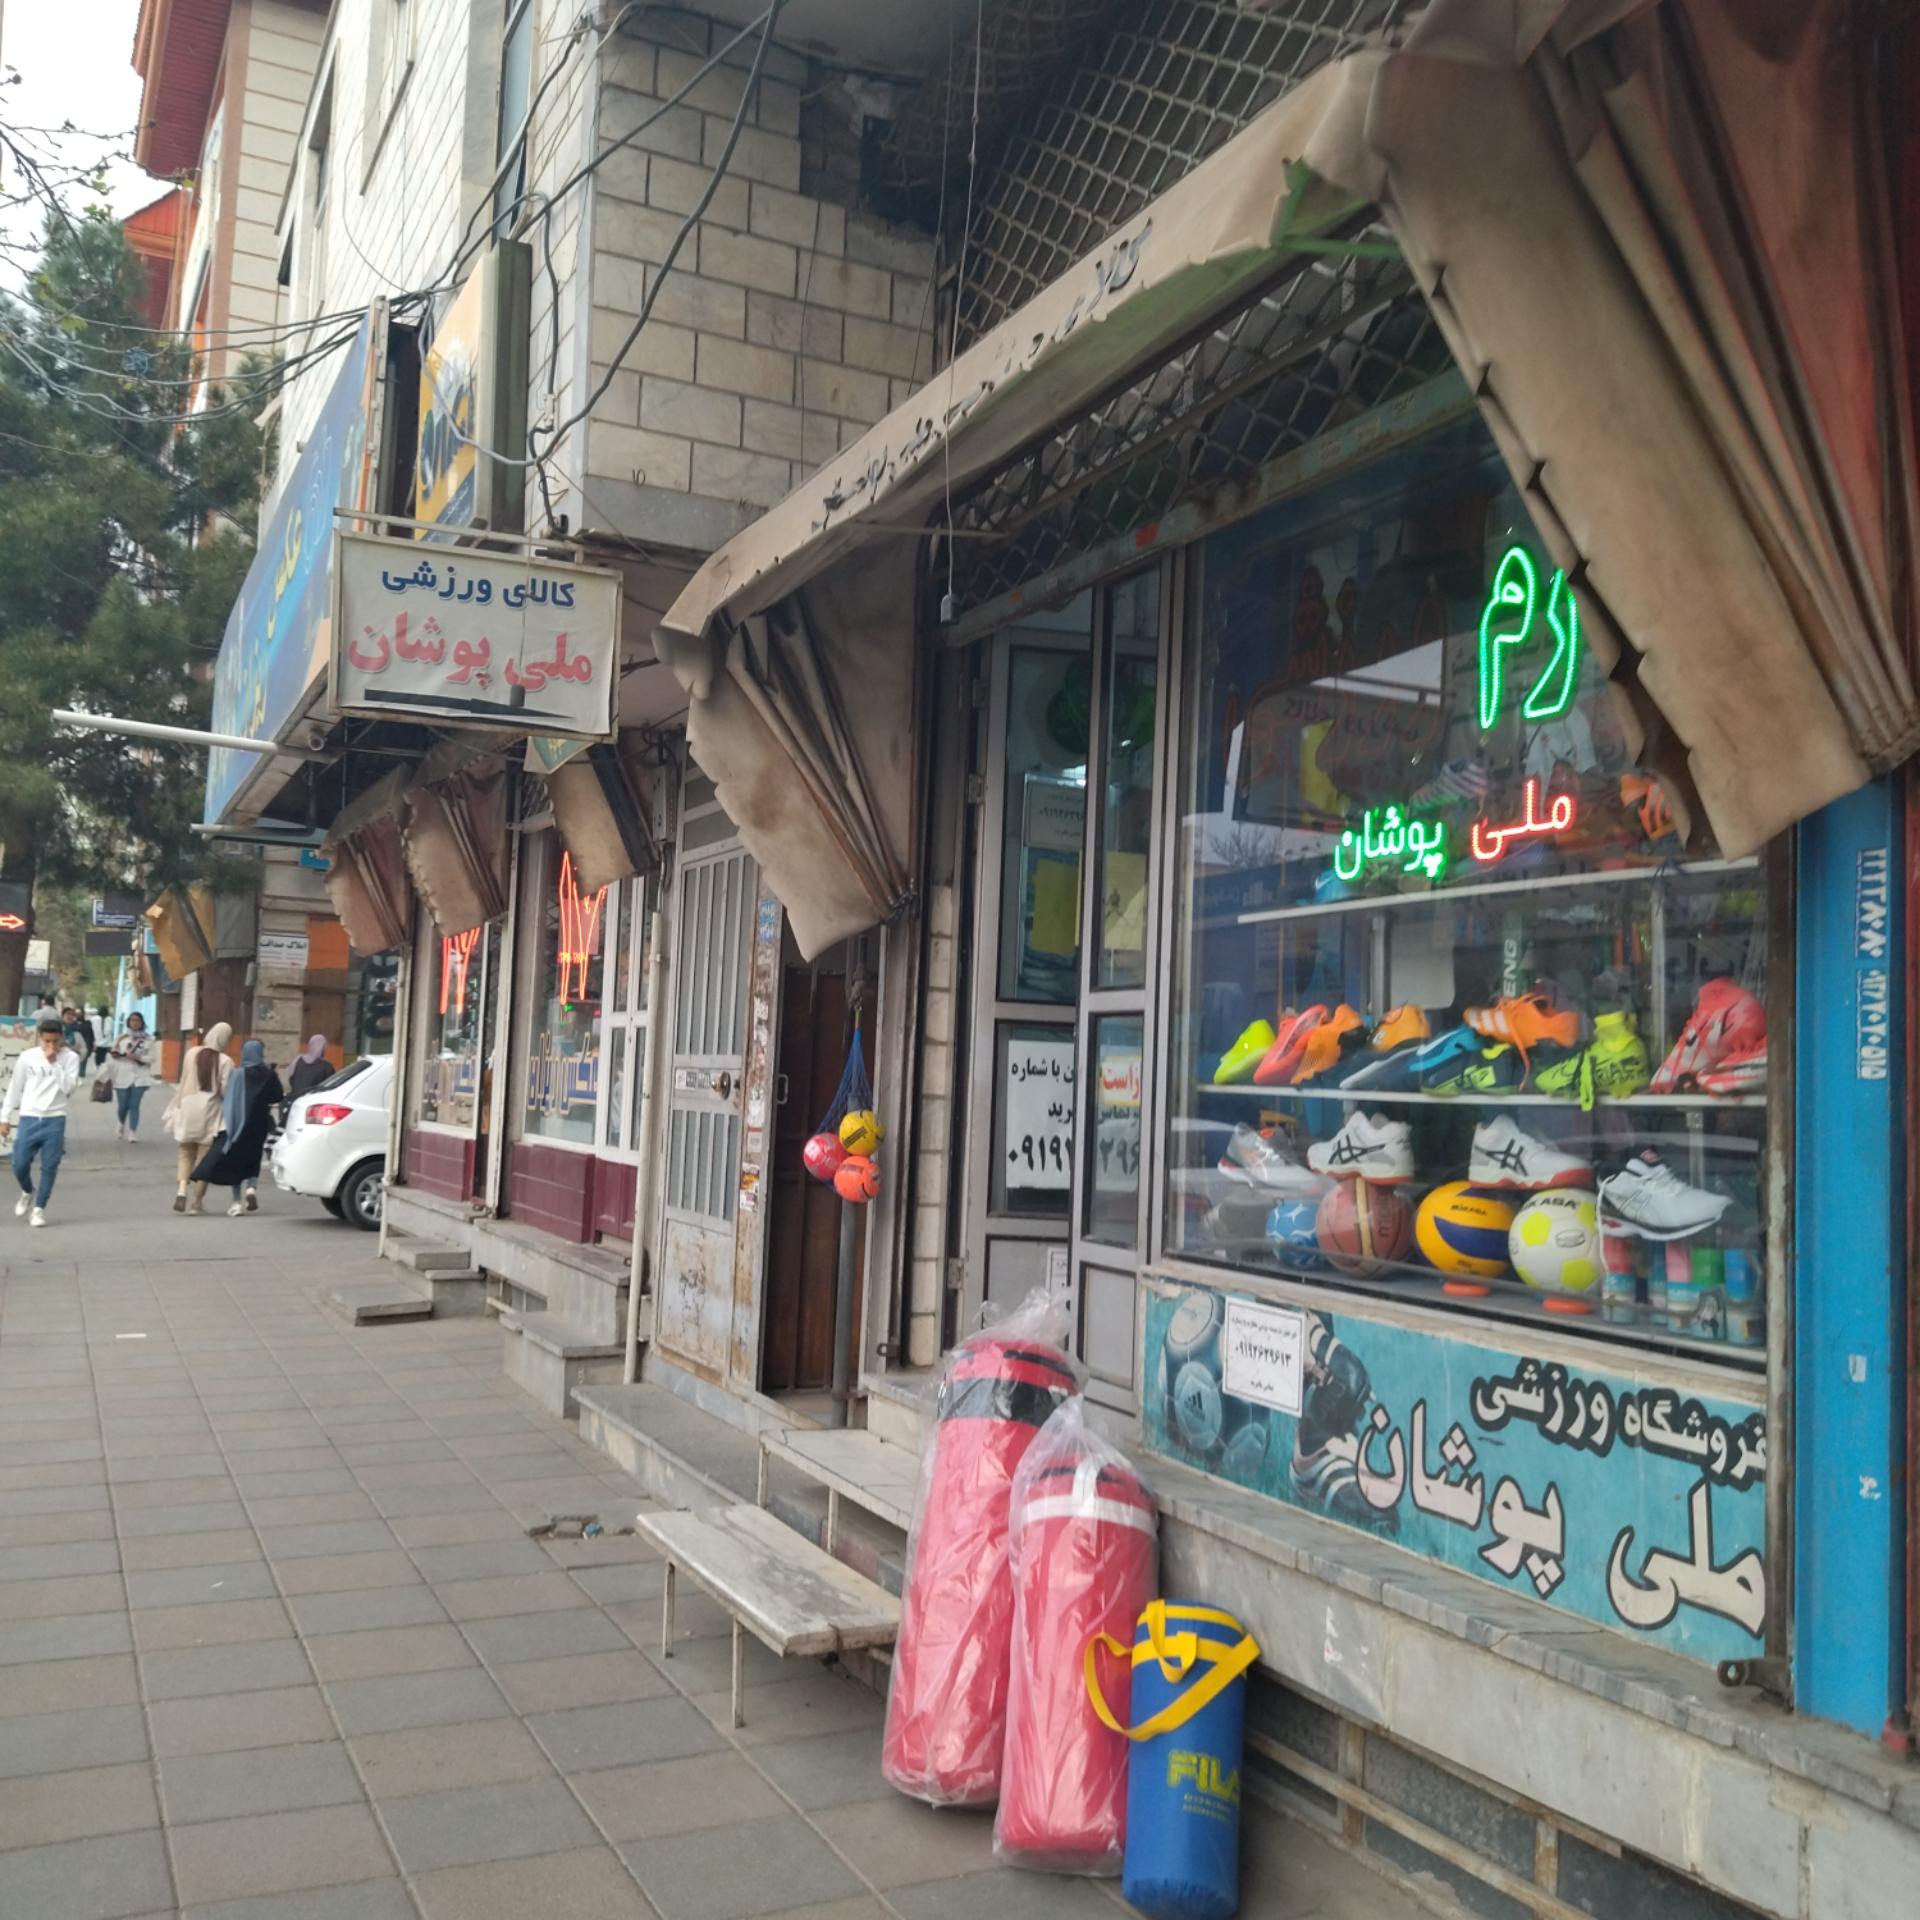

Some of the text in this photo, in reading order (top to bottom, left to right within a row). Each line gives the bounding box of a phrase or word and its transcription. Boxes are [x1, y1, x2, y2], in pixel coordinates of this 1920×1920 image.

[382, 560, 575, 609] کالای ورزشی
[348, 610, 594, 692] ملی پوشان
[1334, 778, 1573, 881] ملی پوشان
[1011, 1057, 1048, 1082] شماره
[1051, 1059, 1061, 1083] با
[1474, 1362, 1611, 1448] ورزشی
[1356, 1399, 1767, 1638] ملی پوشان
